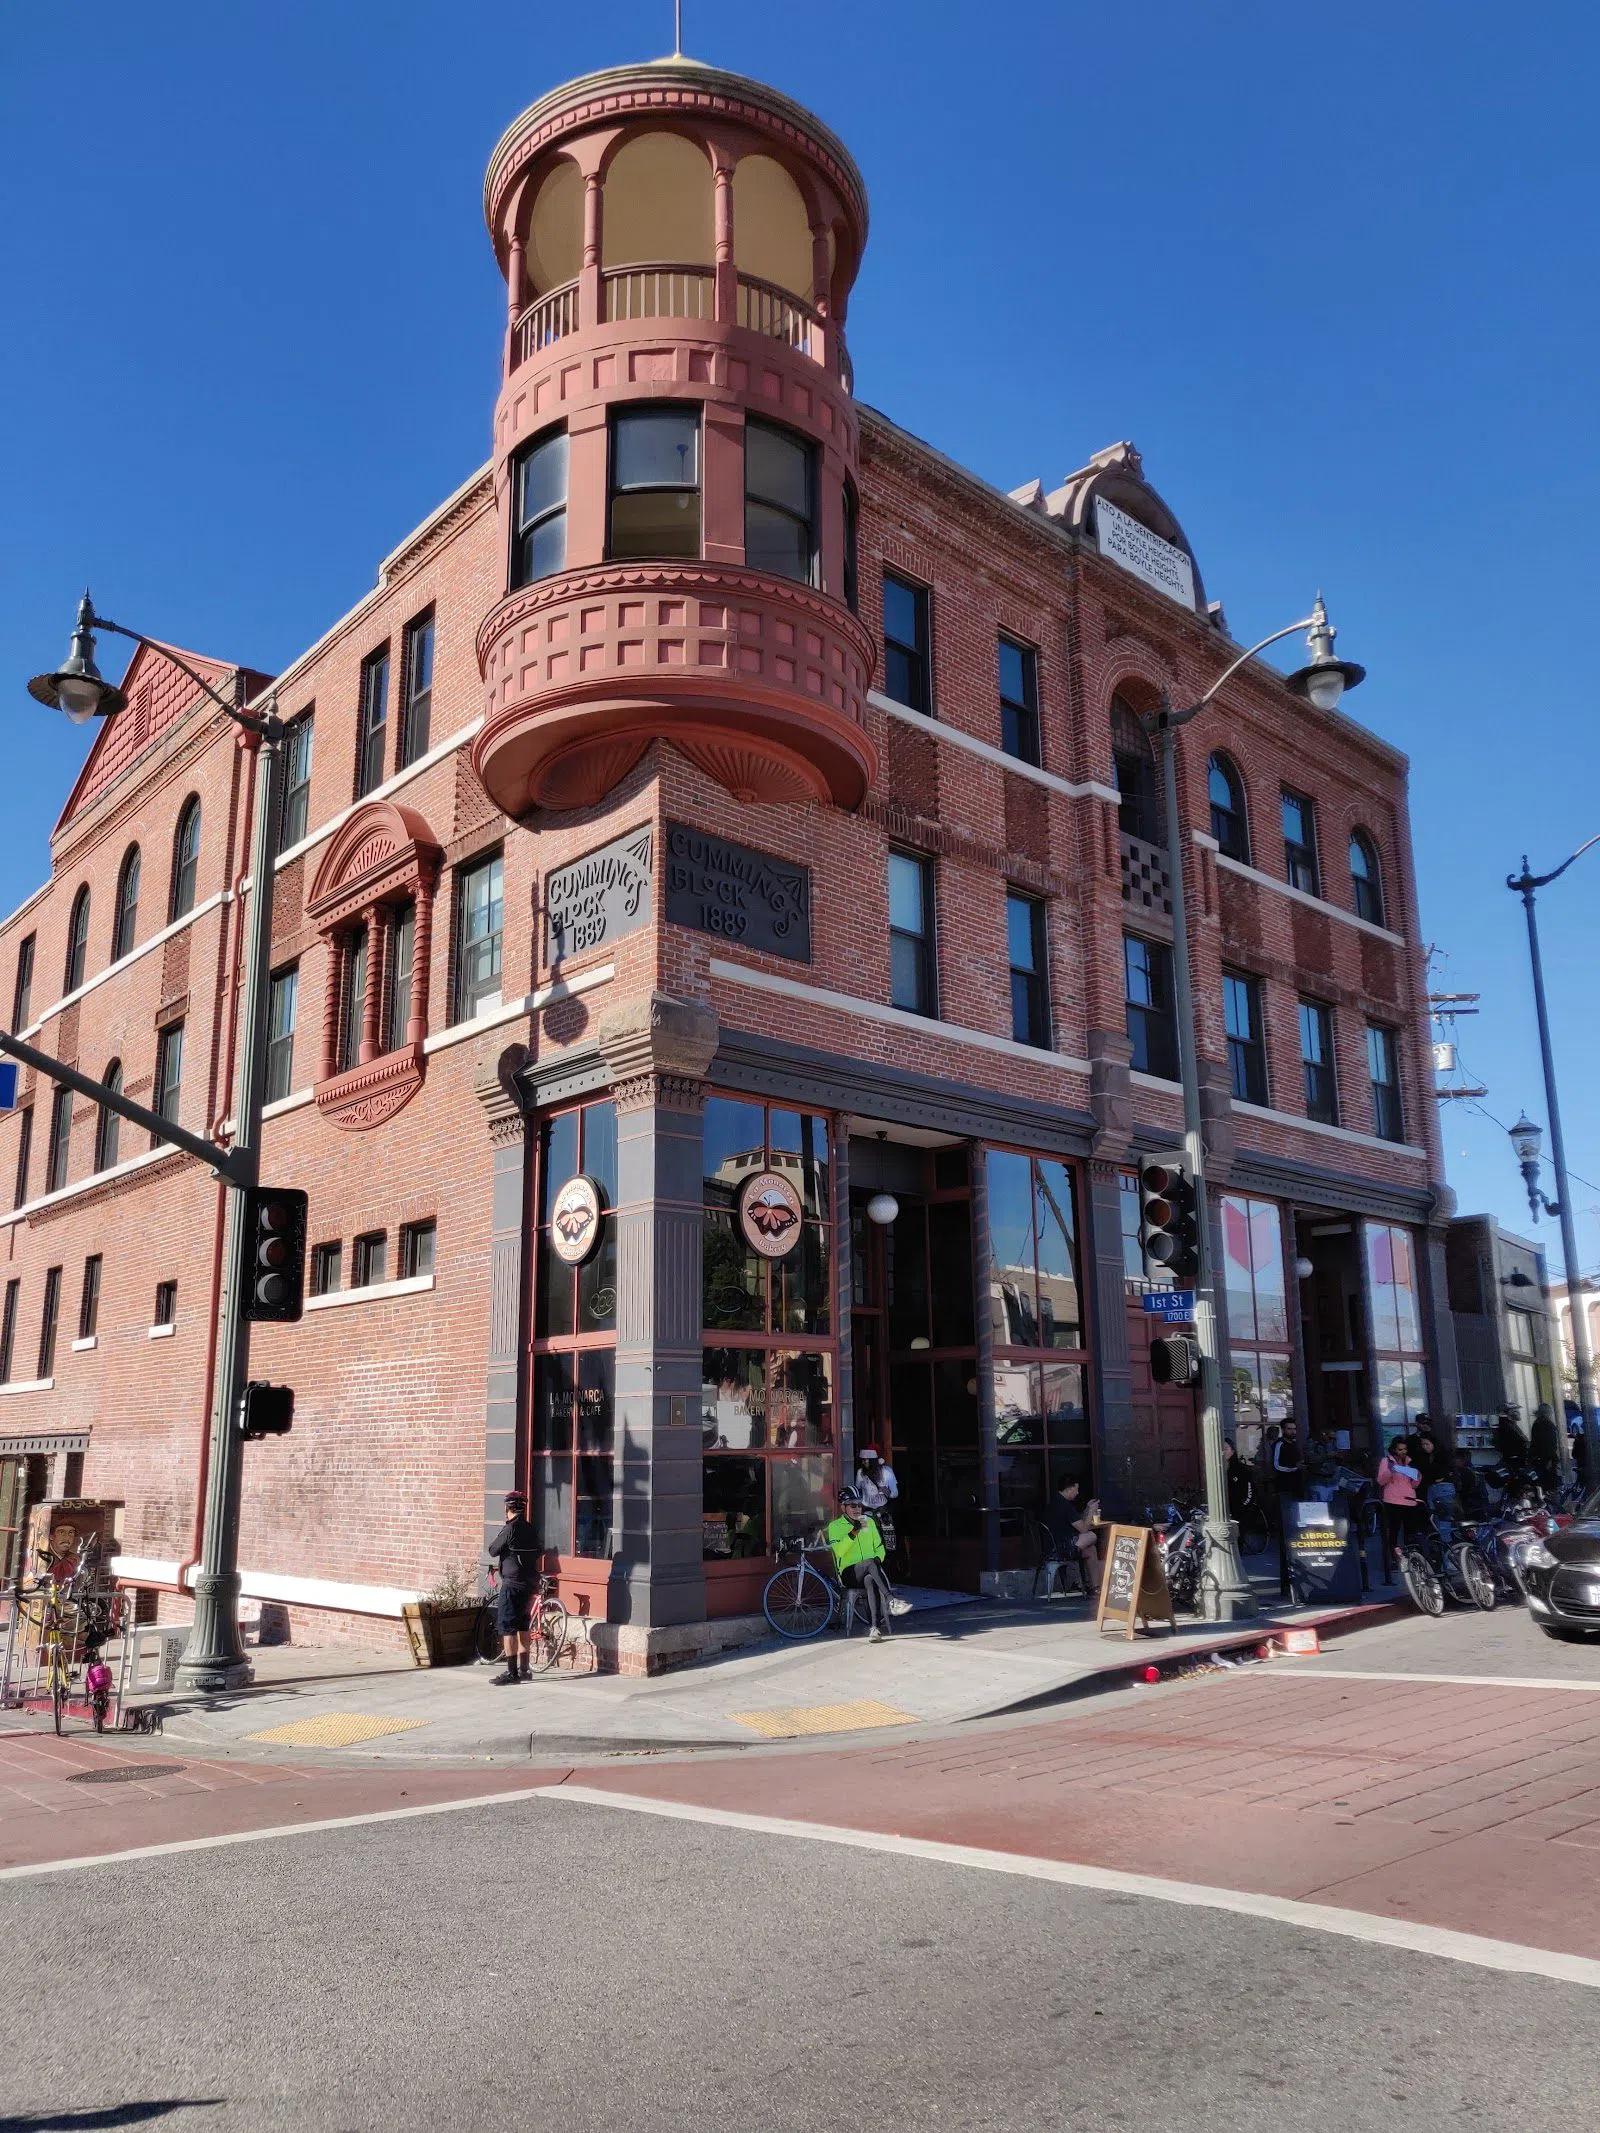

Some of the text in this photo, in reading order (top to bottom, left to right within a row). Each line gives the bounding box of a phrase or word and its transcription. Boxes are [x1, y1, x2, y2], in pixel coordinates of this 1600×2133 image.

[1097, 499, 1115, 516] ALTO
[1117, 512, 1122, 522] A
[1124, 515, 1133, 530] LA
[1112, 521, 1124, 535] UN
[1125, 528, 1147, 549] BOYLE
[1112, 530, 1127, 546] POR
[1128, 541, 1149, 561] BOYLE
[1107, 537, 1128, 557] PARA
[1129, 551, 1154, 574] BOYLE
[551, 857, 648, 917] CUMMINGS
[670, 864, 748, 910] BLOCK
[671, 831, 800, 938] CUMMINGS
[551, 888, 606, 939] BLOCK
[701, 903, 748, 937] 1889
[573, 915, 607, 953] 1889
[1151, 1294, 1184, 1309] 1st St
[1167, 1311, 1190, 1321] 1700 E
[1290, 1540, 1348, 1548] SCHMIBROS
[1300, 1532, 1337, 1540] LIBROS
[164, 1657, 173, 1681] SERVICES
